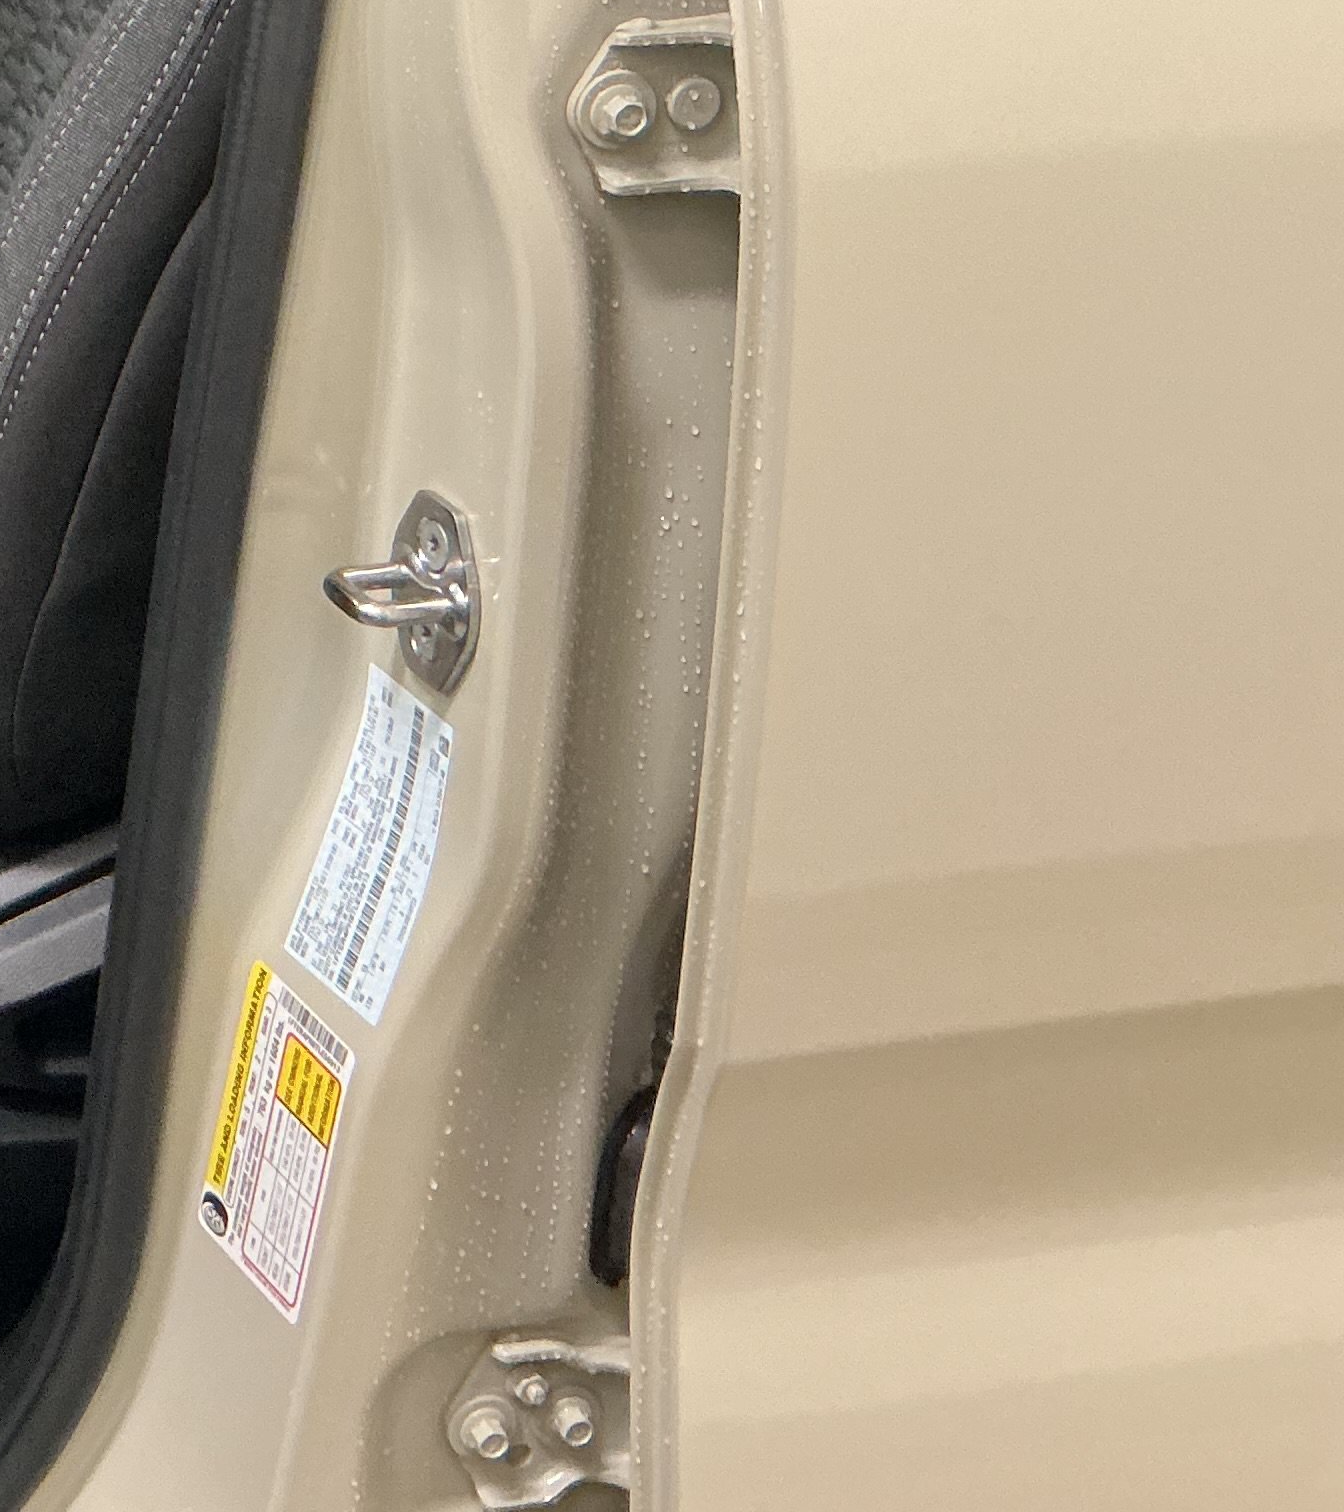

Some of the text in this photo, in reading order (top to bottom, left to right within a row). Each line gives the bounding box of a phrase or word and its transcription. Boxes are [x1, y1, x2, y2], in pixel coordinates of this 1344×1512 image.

[211, 1152, 225, 1185] TIRE
[219, 1121, 232, 1153] AND
[226, 1063, 245, 1123] LOADING
[239, 967, 267, 1063] INFORMATION
